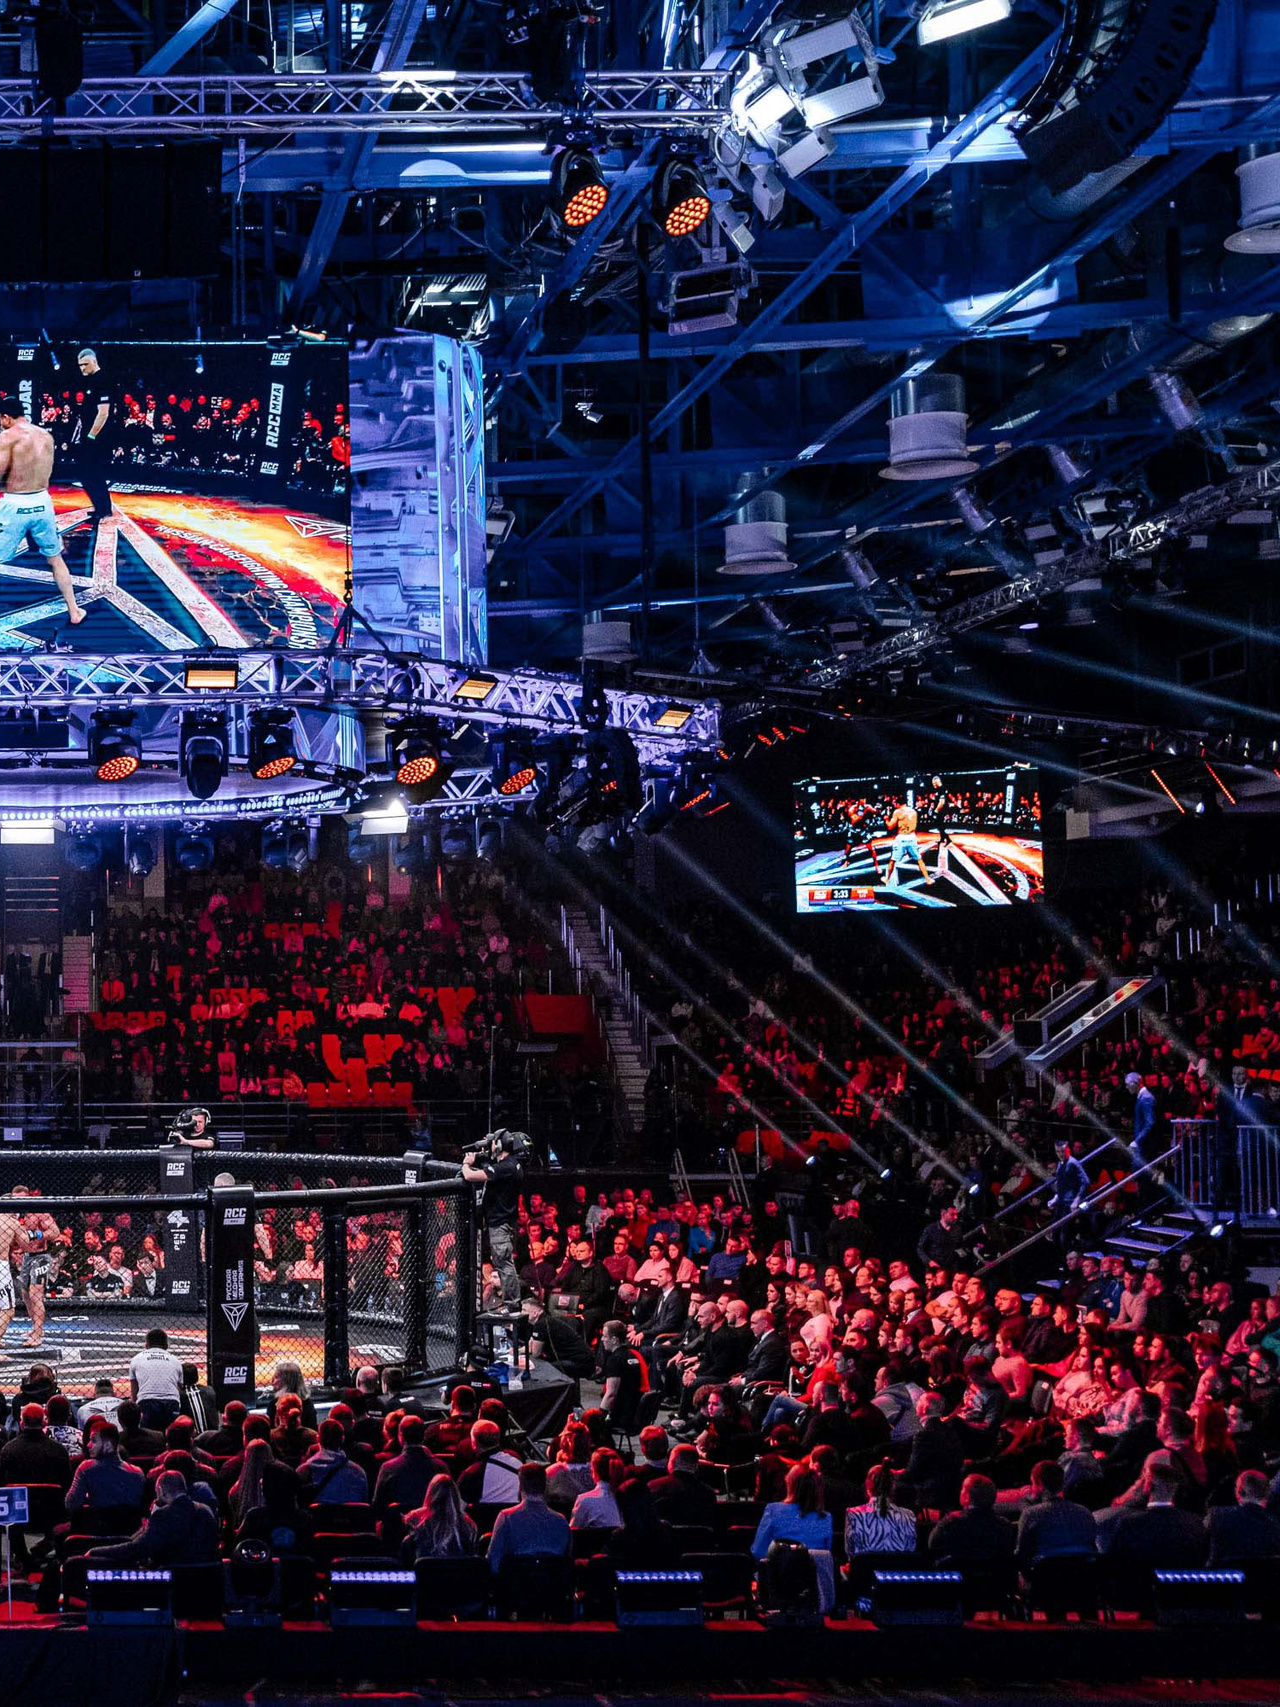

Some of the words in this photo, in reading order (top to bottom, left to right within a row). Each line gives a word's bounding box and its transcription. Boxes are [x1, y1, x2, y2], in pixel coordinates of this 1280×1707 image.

[271, 385, 283, 412] MMA
[265, 414, 281, 448] RCC
[261, 462, 279, 470] RCC
[154, 525, 211, 550] RUSSIAN
[833, 889, 849, 899] 3:33
[167, 1162, 185, 1171] RCC
[224, 1208, 247, 1218] RCC
[172, 1280, 190, 1289] RCC
[225, 1366, 248, 1376] RCC
